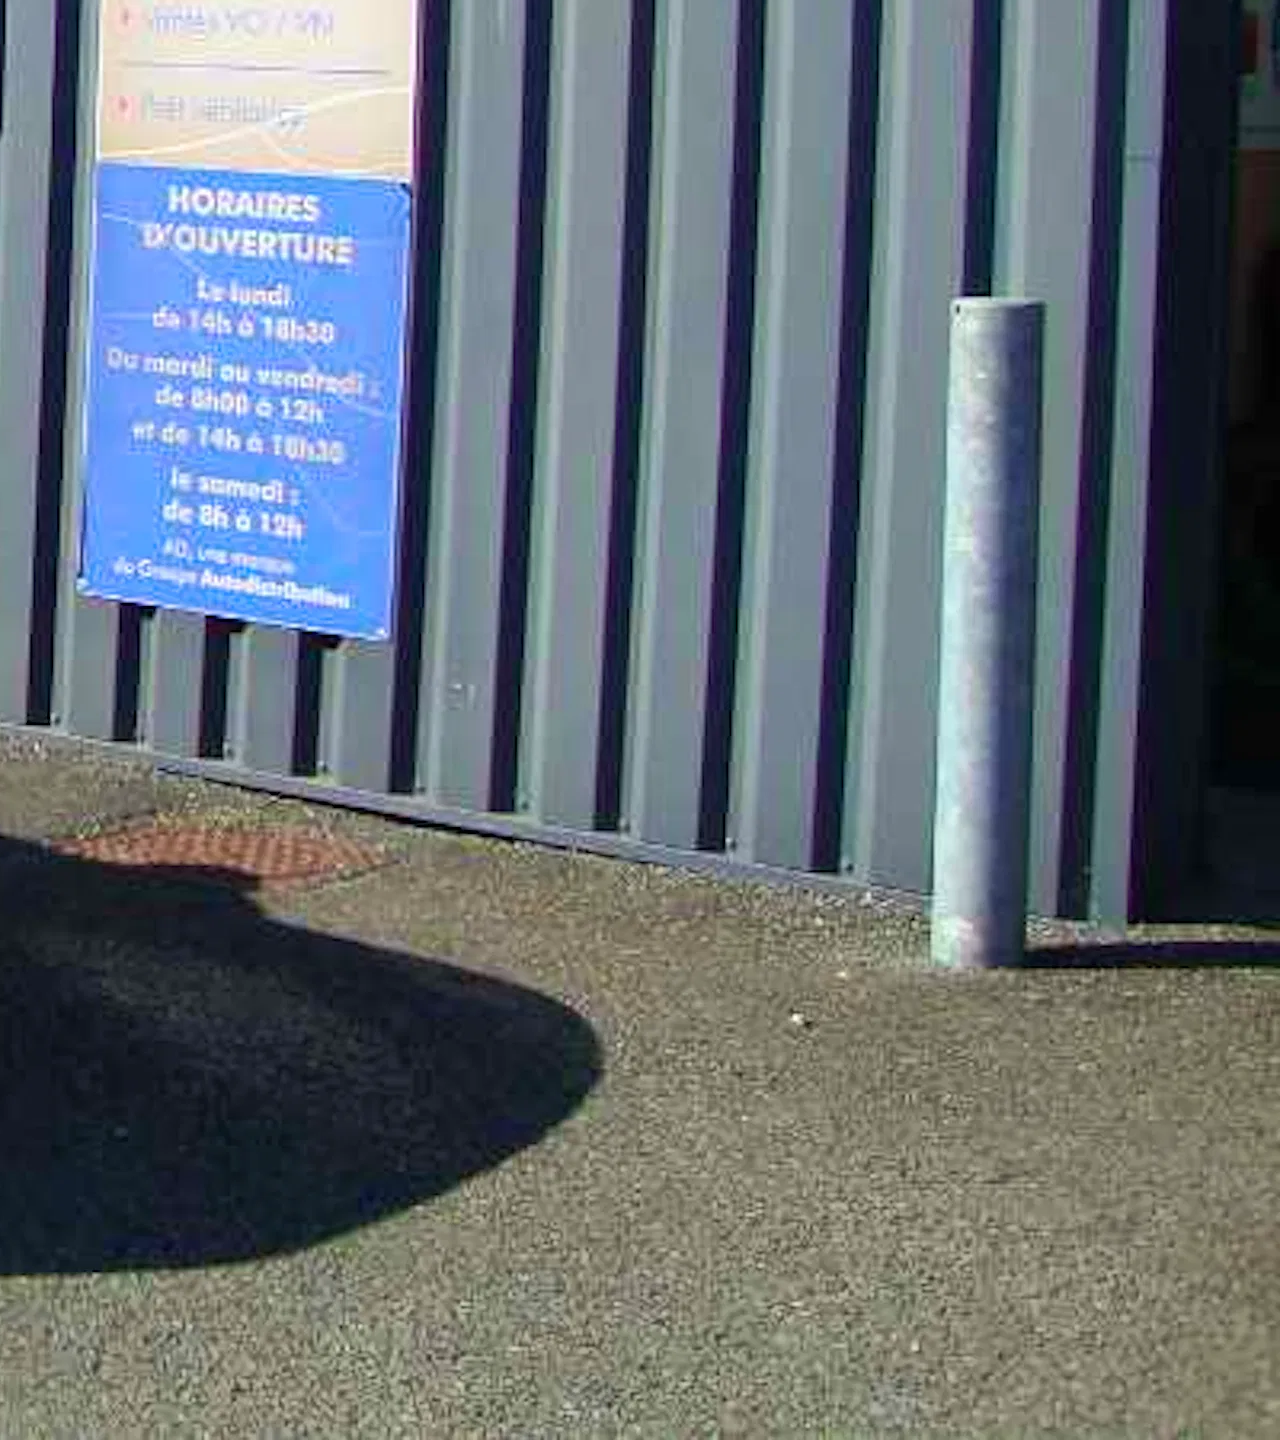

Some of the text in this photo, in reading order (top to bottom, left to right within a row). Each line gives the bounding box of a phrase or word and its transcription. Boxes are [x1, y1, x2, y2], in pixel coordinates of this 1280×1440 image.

[168, 185, 321, 223] HORAIRES
[142, 222, 357, 265] D'OUVERTURE
[233, 281, 291, 306] lundi
[152, 306, 181, 331] de
[189, 309, 232, 336] 14h
[262, 316, 336, 345] 18h30
[144, 354, 213, 380] mardi
[155, 386, 185, 409] de
[280, 398, 325, 424] 12h
[161, 422, 190, 445] de
[198, 424, 241, 452] 14h
[198, 473, 284, 503] samedi
[162, 502, 193, 525] de
[260, 513, 305, 541] 12h
